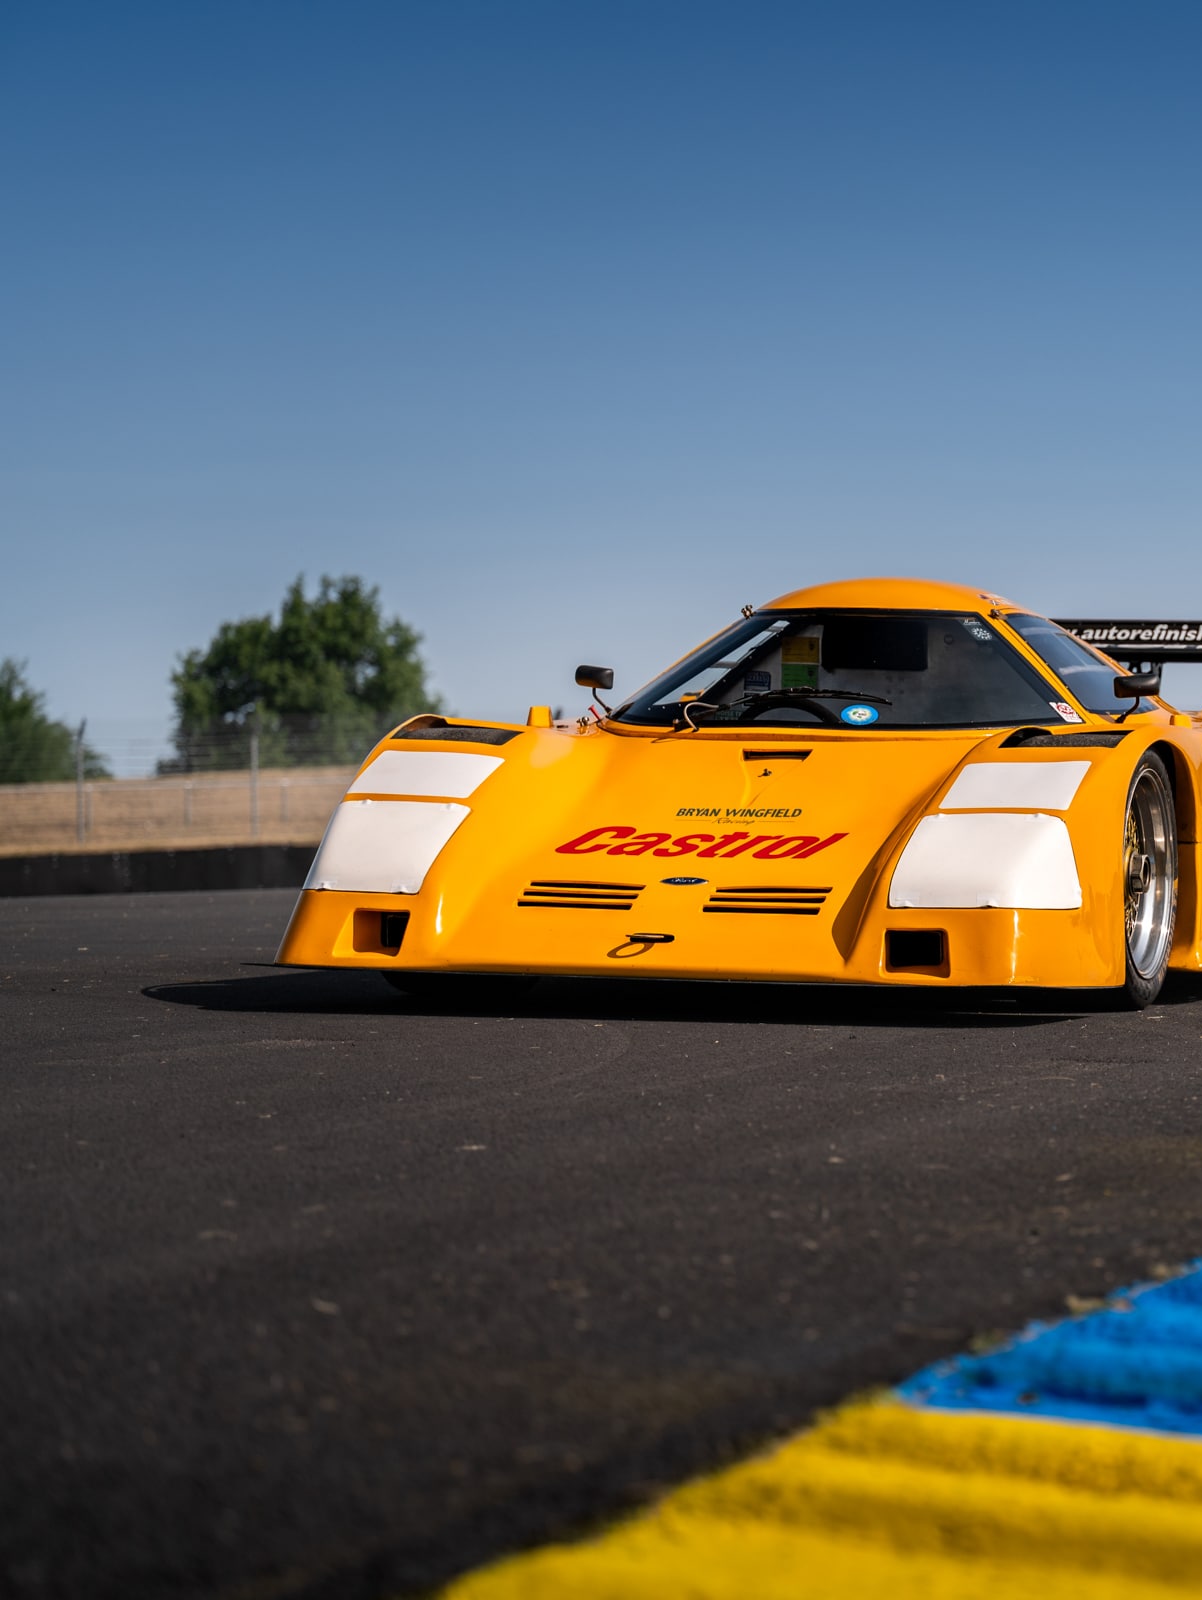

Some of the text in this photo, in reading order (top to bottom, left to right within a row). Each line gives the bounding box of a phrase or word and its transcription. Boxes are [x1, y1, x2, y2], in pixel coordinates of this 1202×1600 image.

[676, 808, 803, 818] BRYAN WINGFIELD
[554, 826, 850, 860] Castrol
